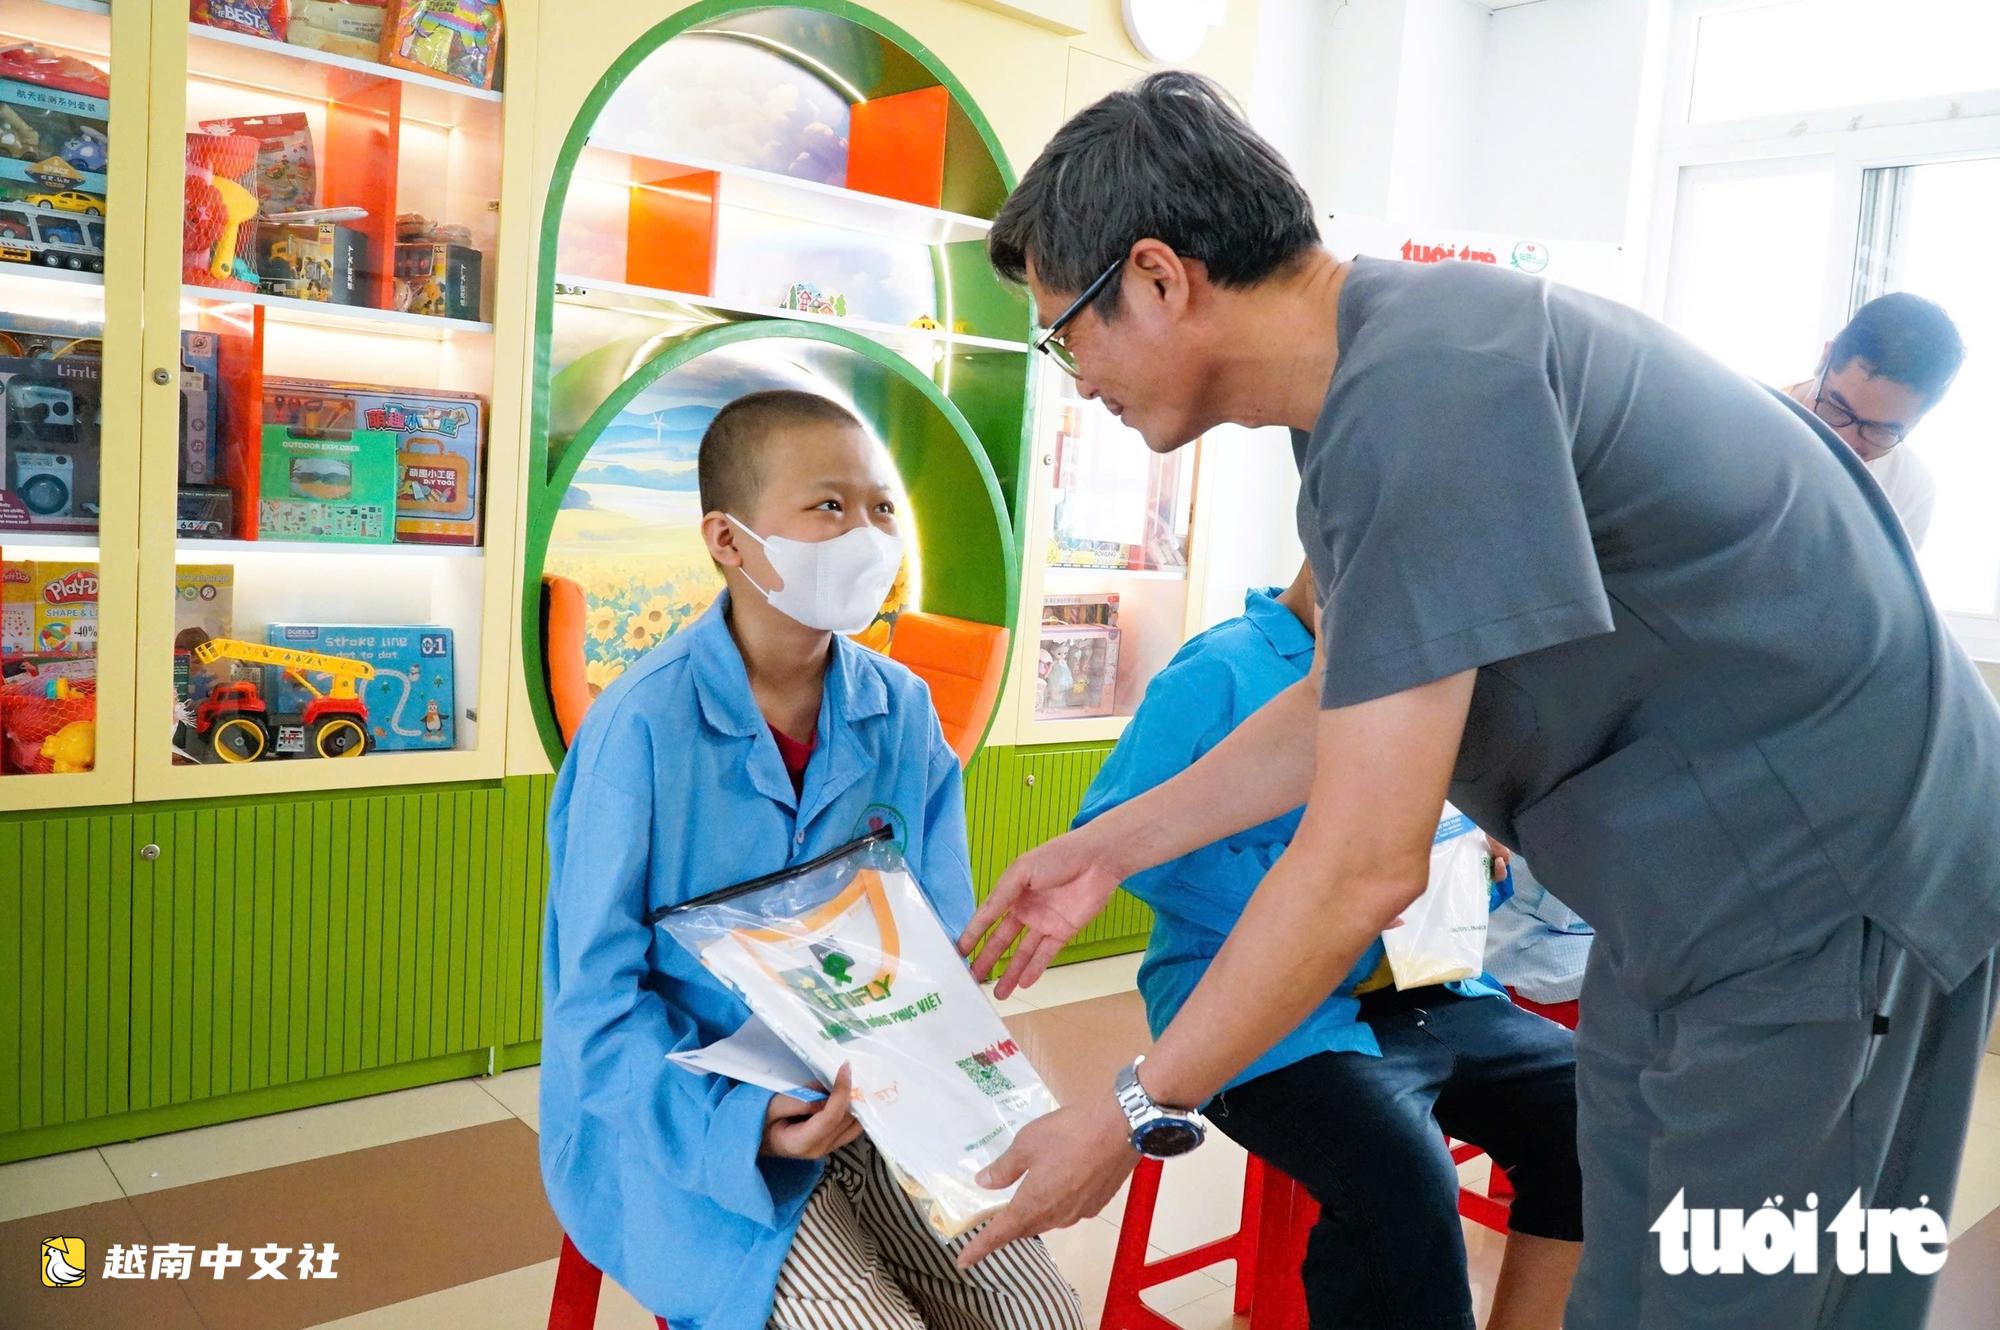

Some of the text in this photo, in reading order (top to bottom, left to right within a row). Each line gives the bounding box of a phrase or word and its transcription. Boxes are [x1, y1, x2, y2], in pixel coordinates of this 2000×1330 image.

[224, 5, 261, 29] BEST
[282, 441, 320, 450] OUTDOOR
[180, 521, 194, 529] 64
[46, 609, 78, 617] SHAPE
[74, 625, 97, 638] -40%
[422, 637, 446, 655] 01
[378, 651, 398, 659] dot
[916, 992, 943, 1013] VIỆT
